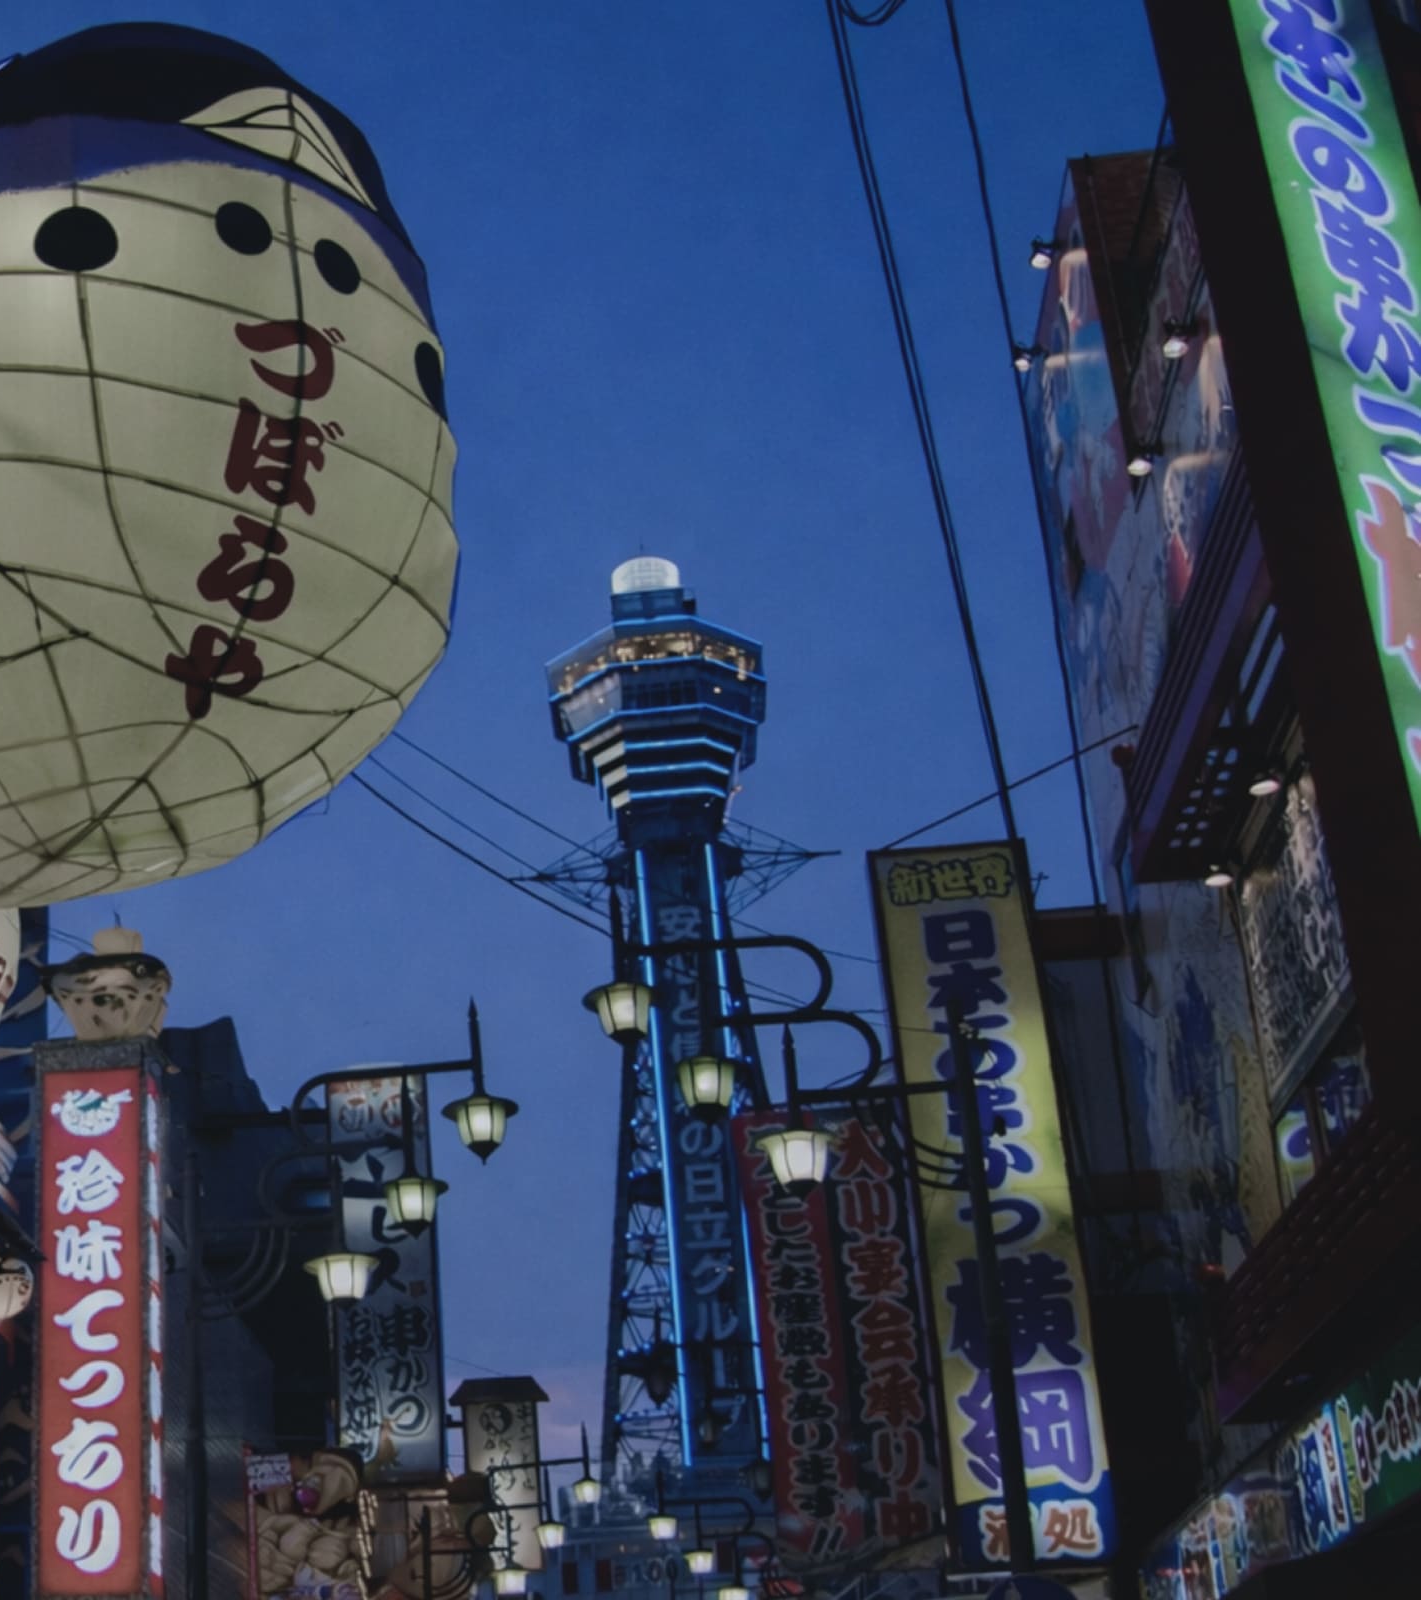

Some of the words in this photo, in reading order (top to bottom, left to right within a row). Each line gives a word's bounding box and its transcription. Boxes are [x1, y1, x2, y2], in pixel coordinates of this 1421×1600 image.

[165, 320, 345, 720] づぼらや
[888, 853, 1014, 906] 新世界
[52, 1149, 126, 1574] 珍味てっちり
[658, 905, 747, 1433] 安心と信の日立グループ
